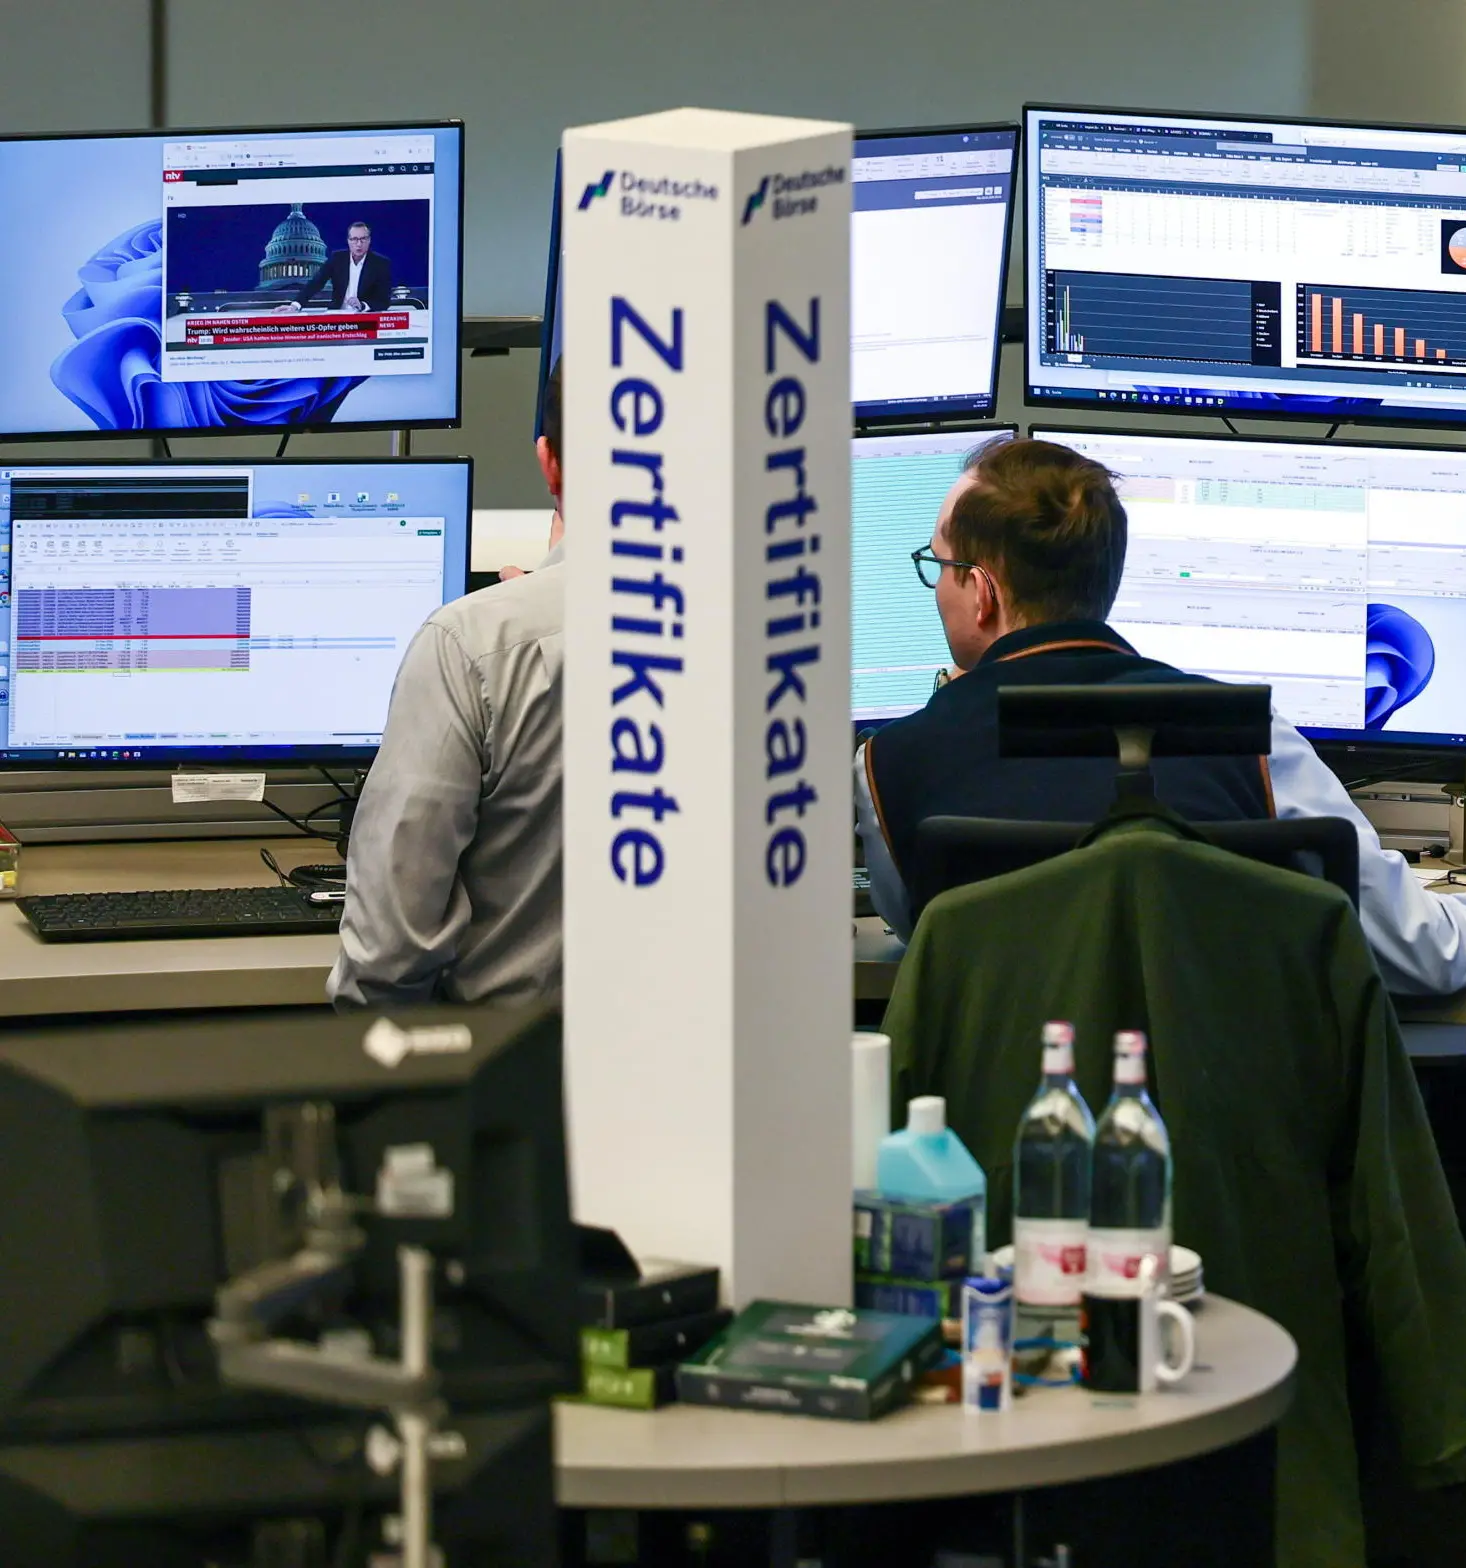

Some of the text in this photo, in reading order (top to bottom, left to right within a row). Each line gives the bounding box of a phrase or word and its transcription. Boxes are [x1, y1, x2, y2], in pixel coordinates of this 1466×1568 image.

[165, 172, 180, 180] ntv
[620, 171, 718, 200] Deutsche
[773, 165, 846, 195] Deutsche
[620, 196, 681, 220] Börse
[772, 196, 818, 220] Börse
[229, 325, 279, 333] wahrscheinlich
[306, 323, 337, 331] US-Opfer
[338, 323, 358, 332] geben
[610, 295, 686, 888] Zertifikate
[765, 295, 822, 888] Zertifikate
